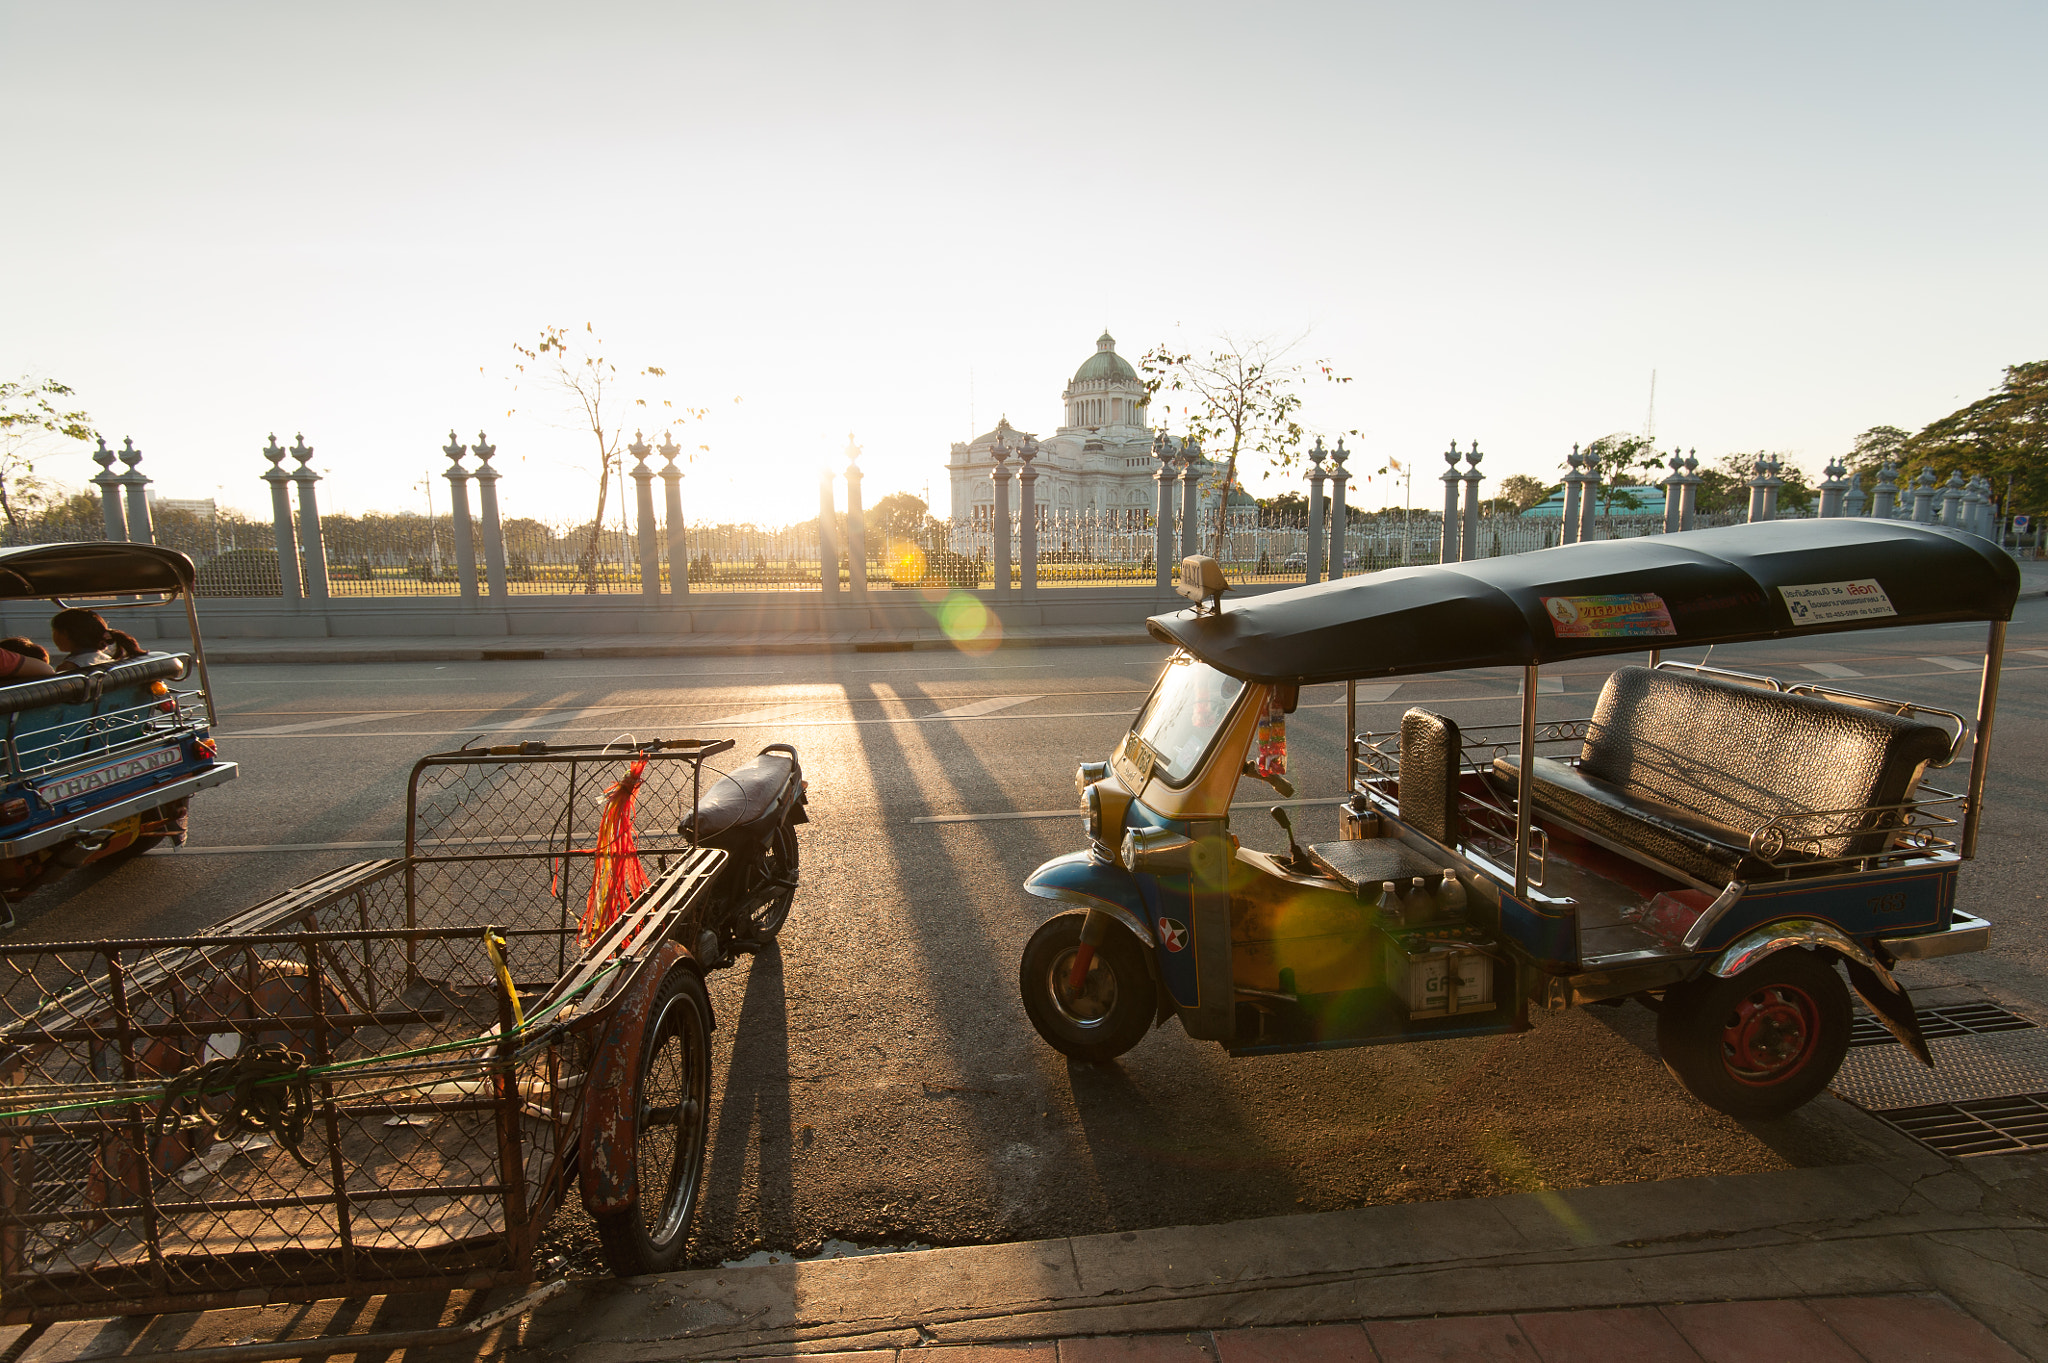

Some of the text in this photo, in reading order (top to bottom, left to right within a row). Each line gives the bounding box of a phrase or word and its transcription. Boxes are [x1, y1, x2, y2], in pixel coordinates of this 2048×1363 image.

[1183, 562, 1200, 588] TAXI
[1831, 587, 1843, 595] 56
[1846, 583, 1878, 596] เลือก
[49, 750, 176, 801] THAILAND
[1867, 892, 1907, 913] 763
